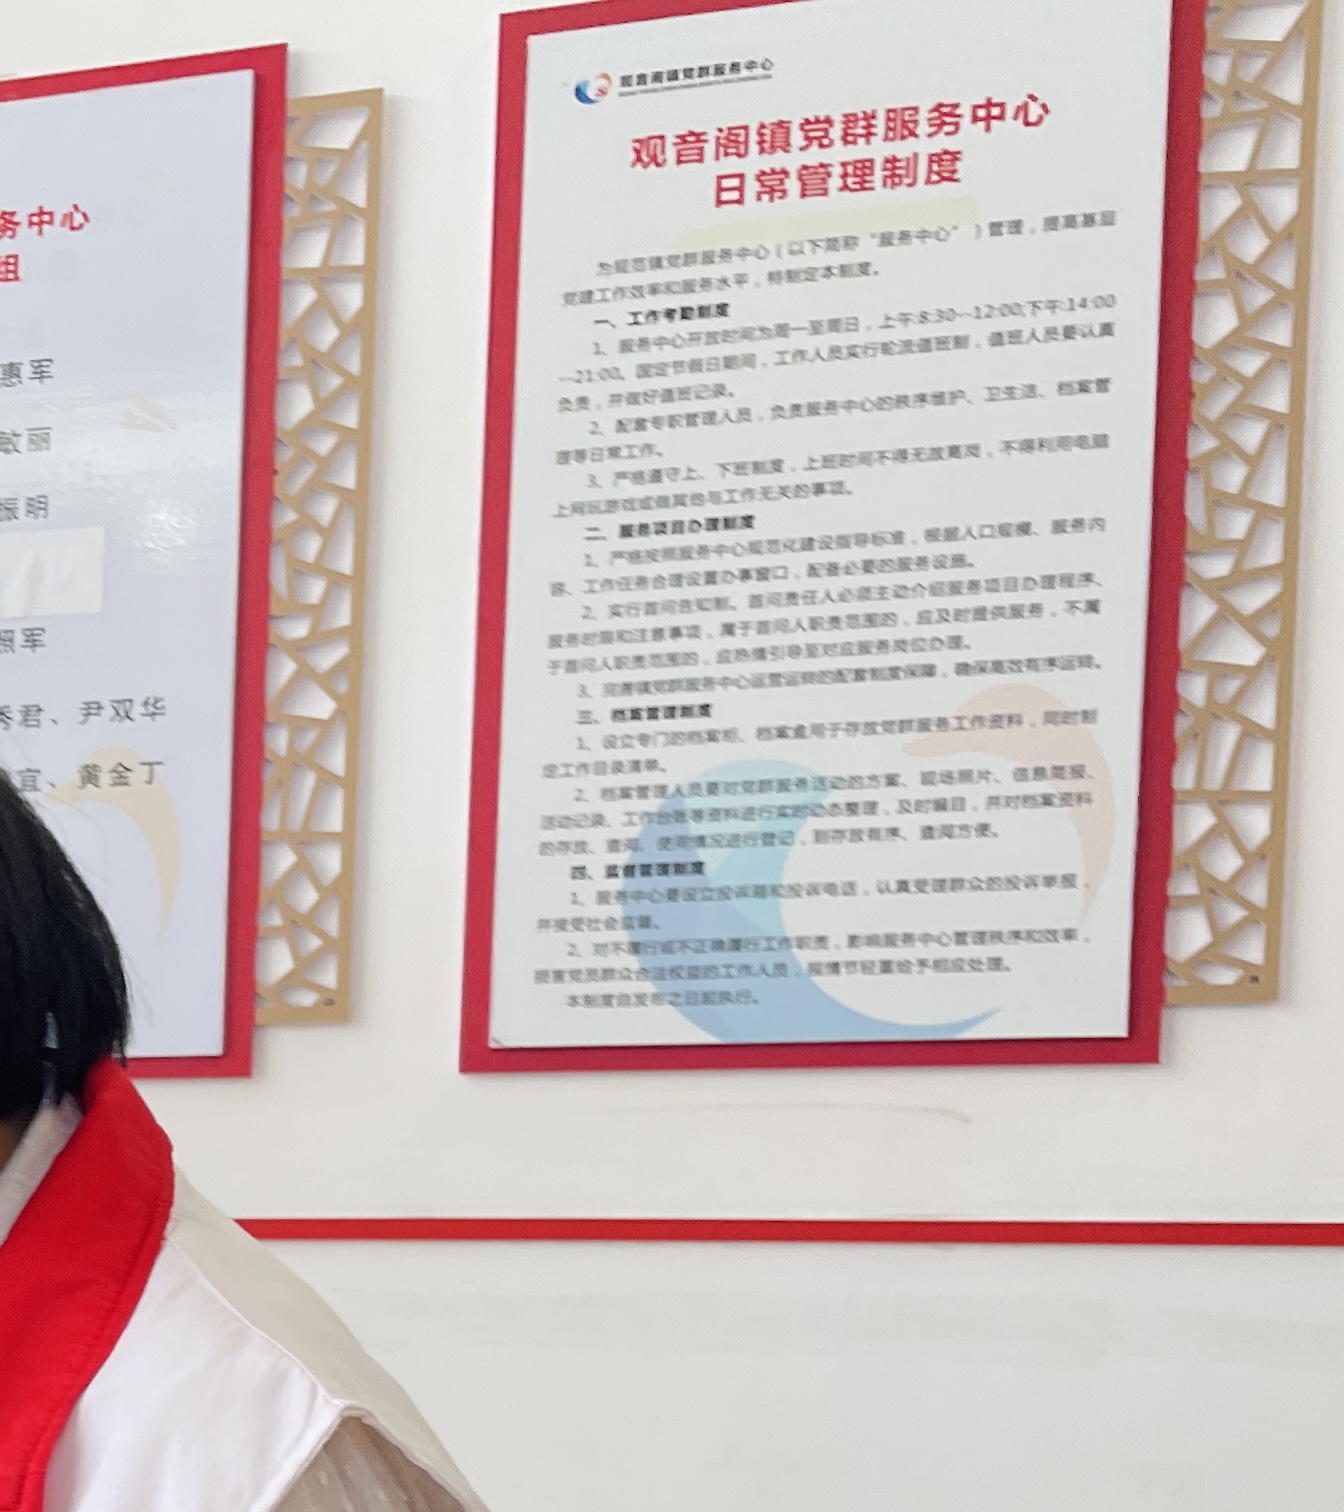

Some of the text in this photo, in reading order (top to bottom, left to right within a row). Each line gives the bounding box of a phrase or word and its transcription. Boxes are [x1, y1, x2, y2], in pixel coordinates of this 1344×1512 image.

[630, 93, 1051, 170] 观音阁镇党群服务中心
[713, 149, 964, 209] 日常管理制度
